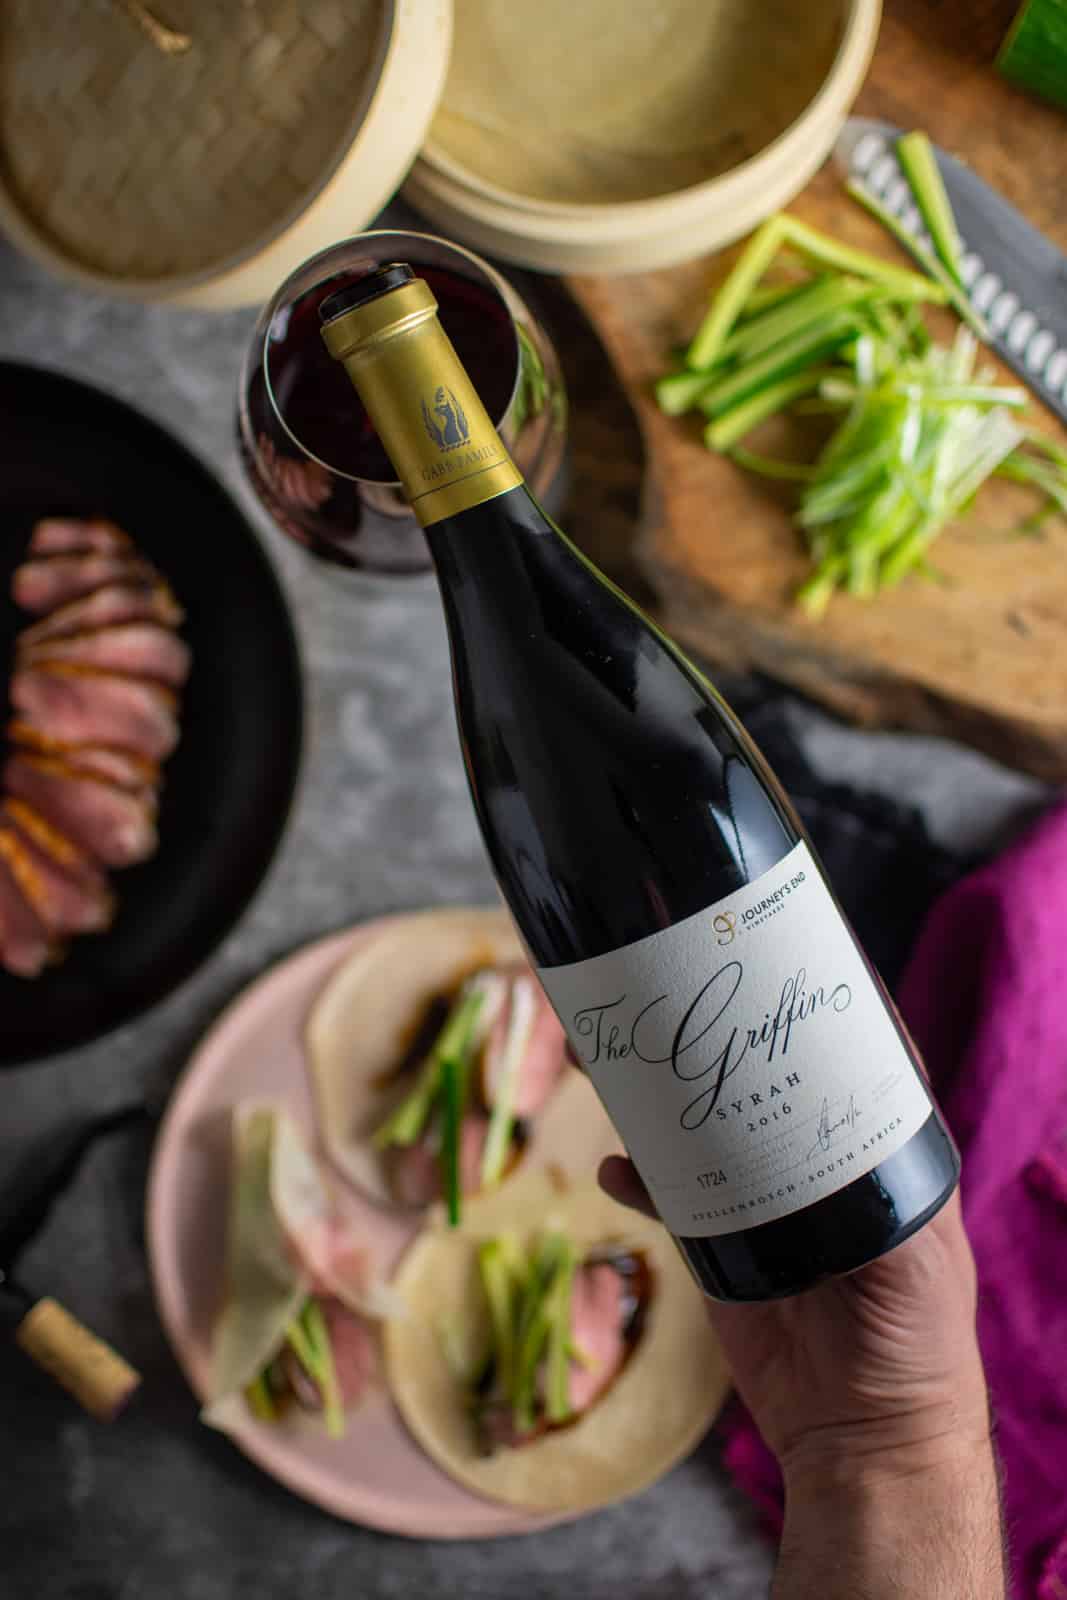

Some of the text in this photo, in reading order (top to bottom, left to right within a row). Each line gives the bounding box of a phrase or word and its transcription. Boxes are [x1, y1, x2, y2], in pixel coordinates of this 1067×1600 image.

[740, 871, 806, 924] JOURNEY'S END
[574, 993, 633, 1064] The
[631, 960, 852, 1130] Griffin
[715, 1071, 801, 1121] SYRAH
[747, 1101, 793, 1132] 2016
[807, 1152, 855, 1184] SOUTH
[861, 1116, 904, 1151] AFRICA
